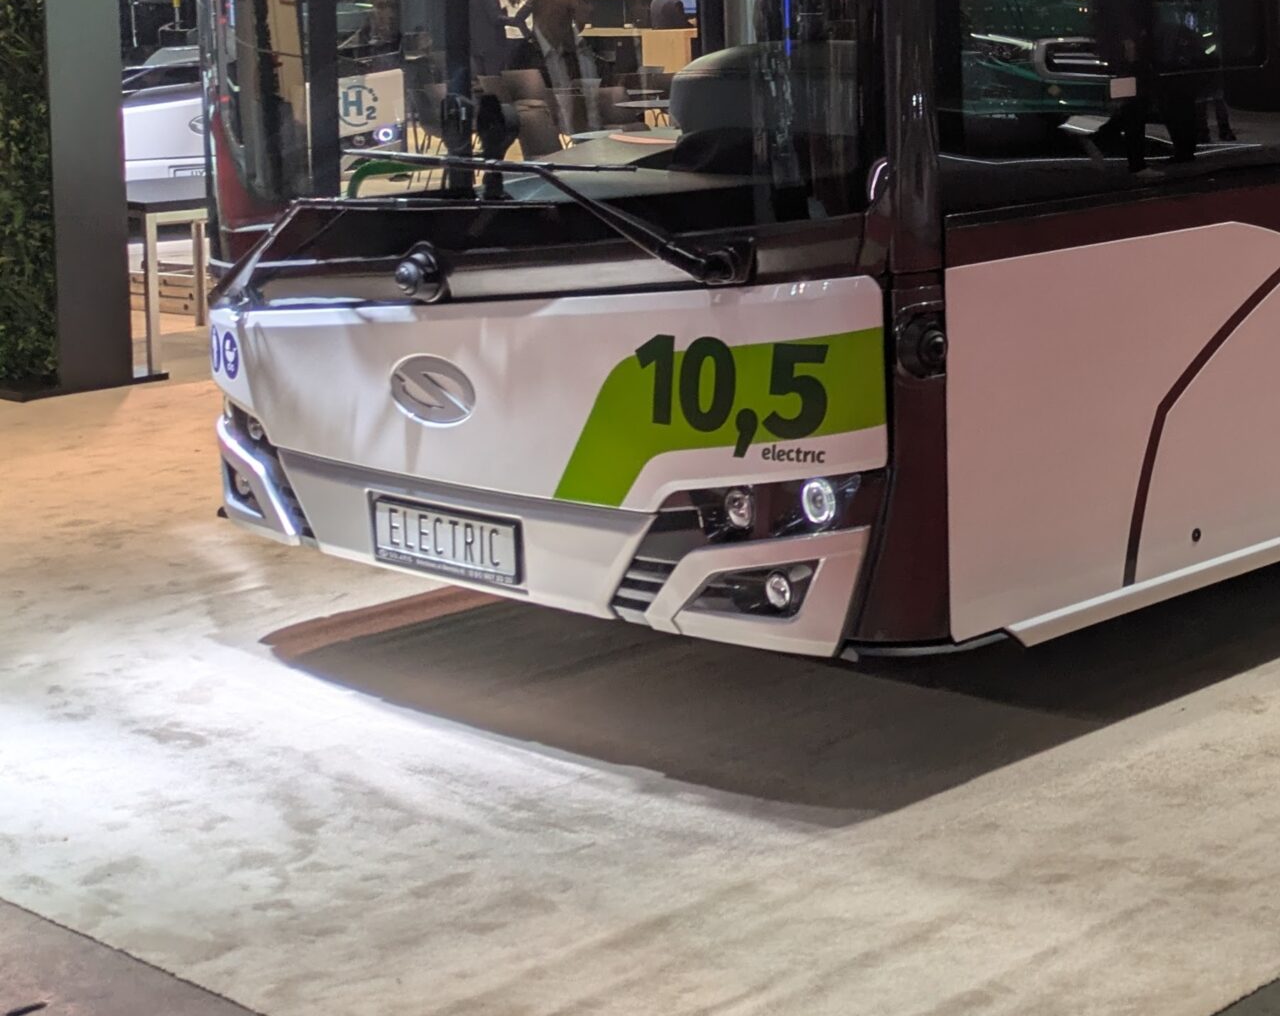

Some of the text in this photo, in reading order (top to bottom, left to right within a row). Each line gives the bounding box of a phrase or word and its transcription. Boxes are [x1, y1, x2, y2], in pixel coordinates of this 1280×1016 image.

[634, 333, 830, 459] 10,5
[761, 444, 827, 465] electric
[388, 507, 502, 567] ELECTRIC
